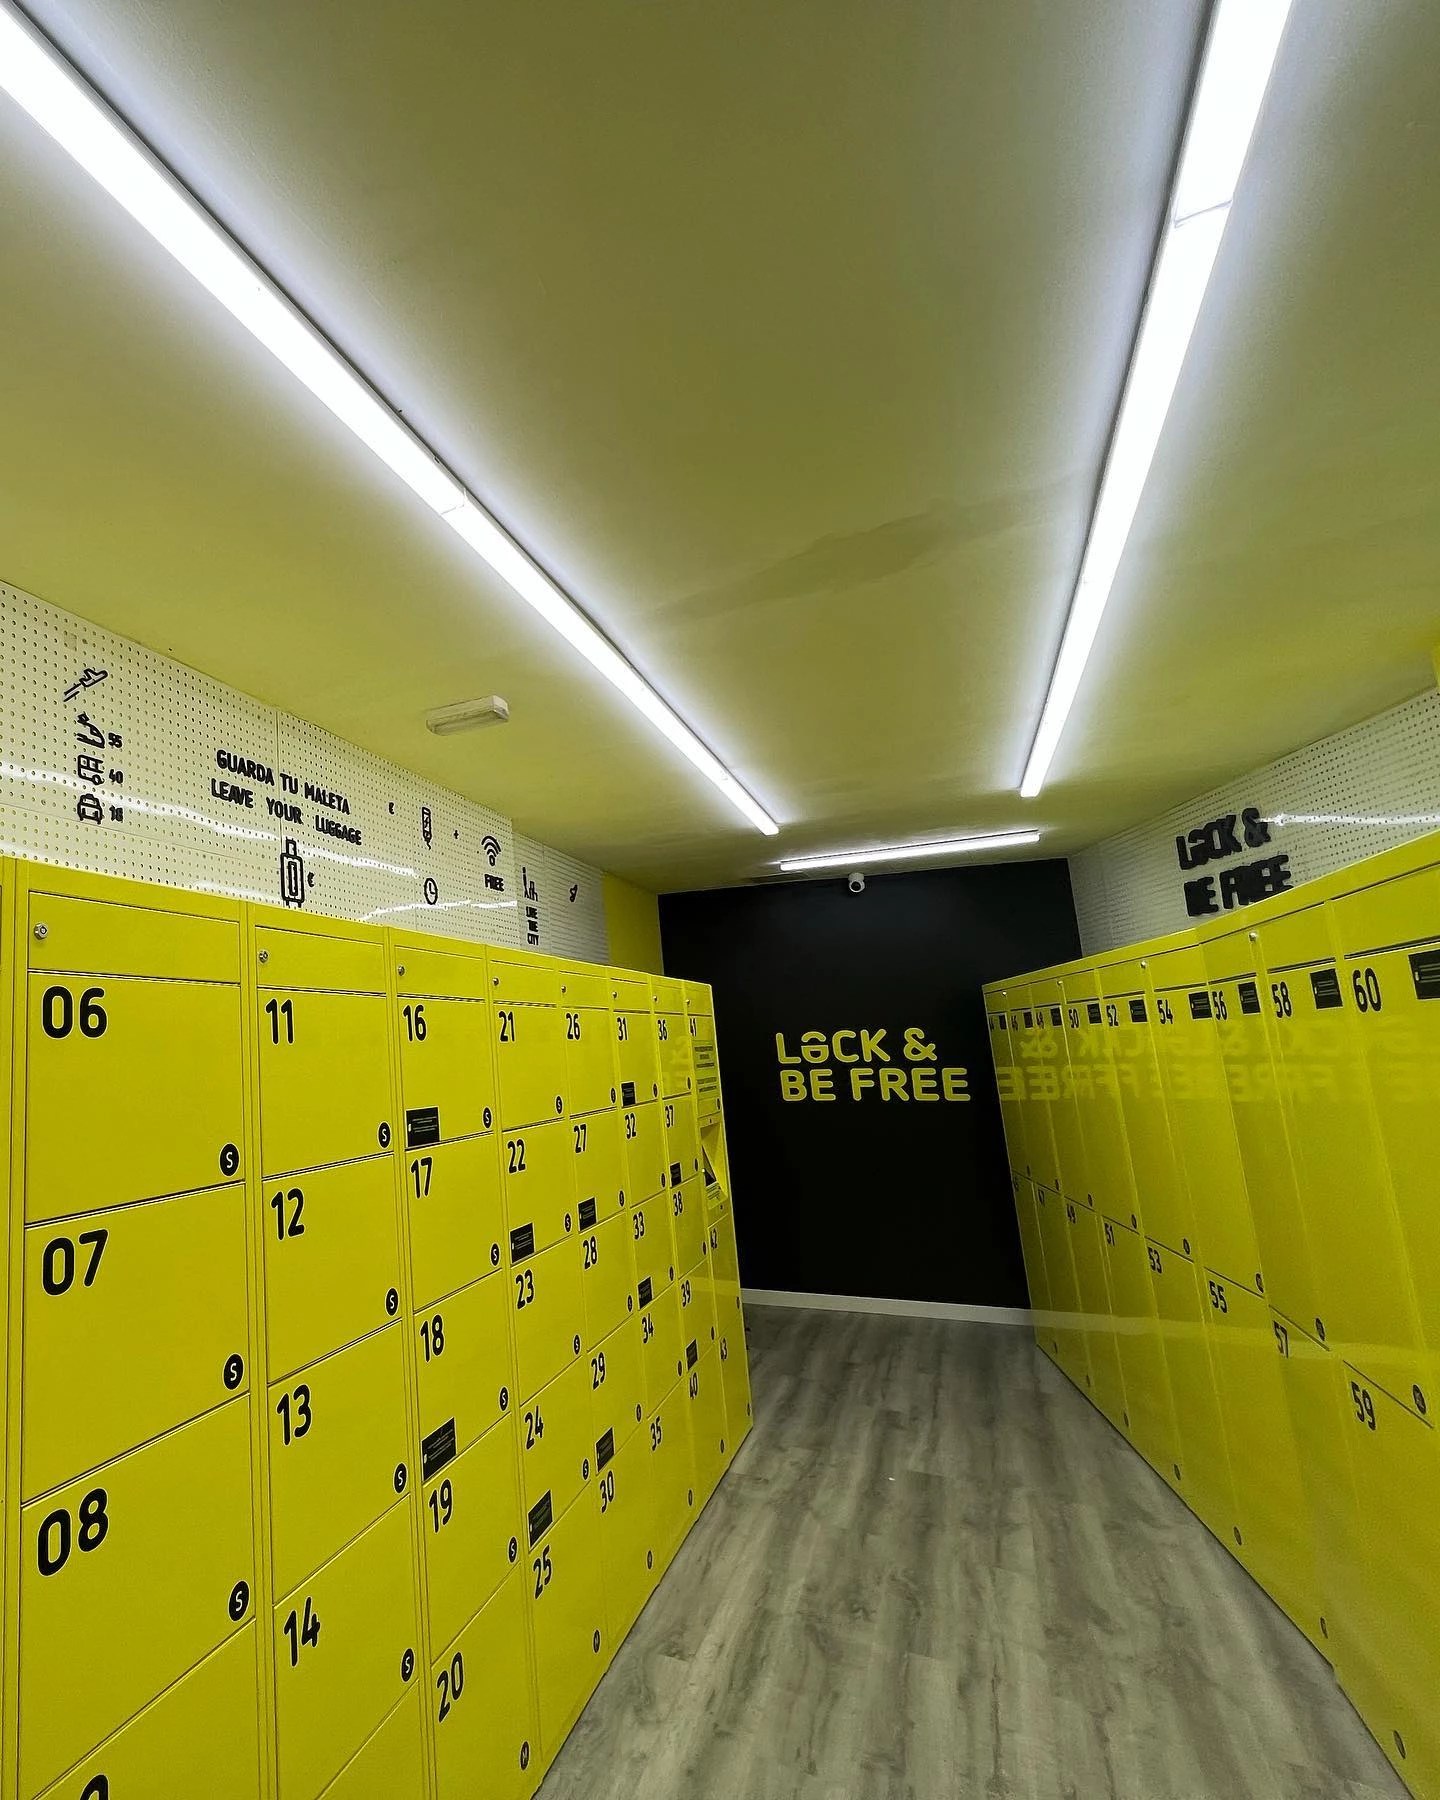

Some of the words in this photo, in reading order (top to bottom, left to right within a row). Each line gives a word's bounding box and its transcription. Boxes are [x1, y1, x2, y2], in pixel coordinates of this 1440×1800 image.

[217, 749, 275, 787] GUARDA
[280, 773, 298, 795] TU
[304, 782, 350, 816] MALETA
[211, 778, 254, 808] LEAVE
[266, 797, 304, 825] YOUR
[315, 815, 362, 845] LUGGAGE
[484, 874, 505, 892] FREE
[1212, 991, 1227, 1020] 56
[1272, 982, 1291, 1018] 58
[1353, 968, 1381, 1012] 60
[43, 986, 107, 1038] 06
[266, 999, 293, 1044] 11
[403, 1005, 426, 1041] 16
[499, 1011, 514, 1041] 21
[566, 1013, 580, 1040] 26
[617, 1018, 627, 1040] 31
[658, 1020, 667, 1040] 36
[1069, 1009, 1079, 1029] 50
[1106, 1005, 1118, 1026] 52
[1157, 1000, 1173, 1024] 54
[775, 1028, 891, 1064] LOCK
[903, 1027, 938, 1061] &
[780, 1068, 836, 1102] BE
[850, 1067, 971, 1102] FREE
[625, 1113, 636, 1139] 32
[665, 1105, 673, 1127] 37
[508, 1139, 525, 1173] 22
[574, 1124, 586, 1153] 27
[411, 1157, 432, 1198] 17
[271, 1189, 304, 1240] 12
[673, 1191, 682, 1216] 38
[633, 1212, 644, 1239] 33
[1105, 1223, 1114, 1246] 51
[42, 1230, 108, 1295] 07
[583, 1236, 597, 1269] 28
[1148, 1247, 1162, 1273] 53
[516, 1270, 533, 1309] 23
[682, 1280, 690, 1306] 39
[1209, 1281, 1228, 1313] 55
[421, 1315, 444, 1362] 18
[642, 1314, 653, 1343] 34
[1274, 1321, 1288, 1358] 57
[591, 1353, 605, 1389] 29
[277, 1385, 311, 1445] 13
[1352, 1381, 1375, 1430] 59
[525, 1406, 543, 1449] 24
[651, 1417, 661, 1451] 35
[429, 1479, 452, 1532] 19
[600, 1471, 613, 1513] 30
[38, 1489, 108, 1576] 08
[533, 1545, 551, 1598] 25
[284, 1597, 320, 1666] 14
[437, 1652, 463, 1722] 20
